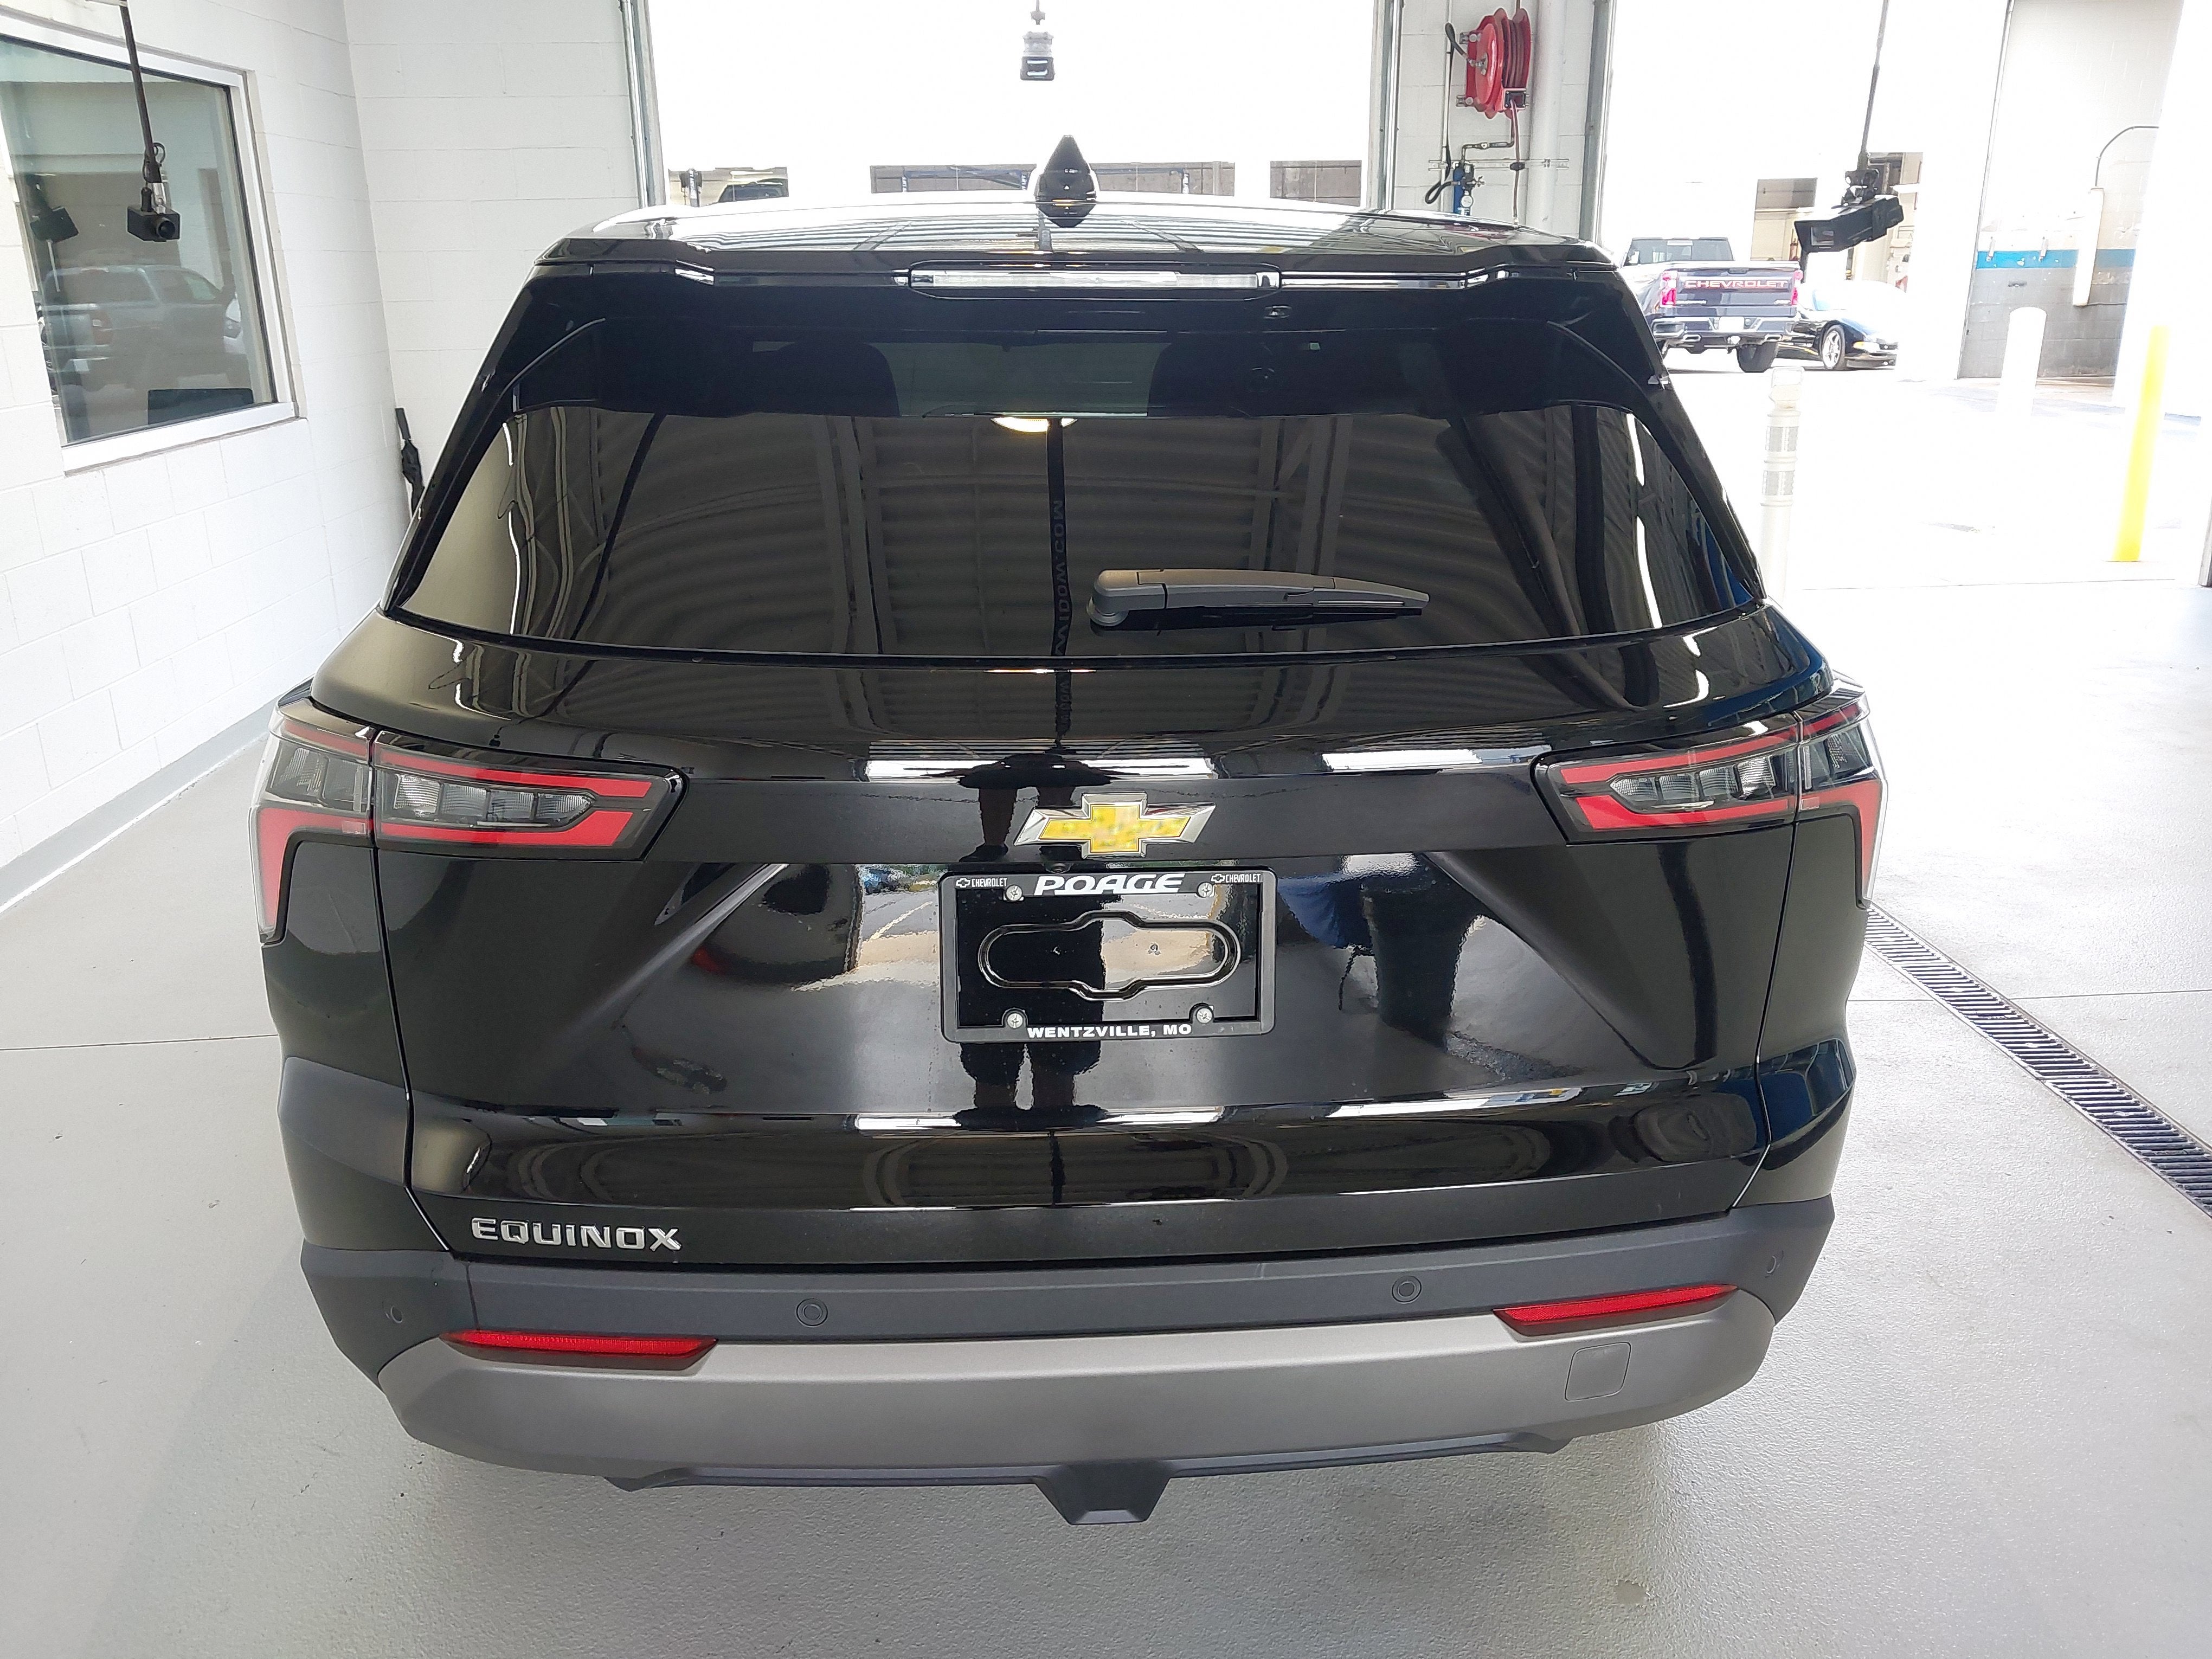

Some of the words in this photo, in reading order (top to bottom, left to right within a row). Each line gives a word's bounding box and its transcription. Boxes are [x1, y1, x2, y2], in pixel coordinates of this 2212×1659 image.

[972, 878, 1007, 888] CHEVROLET
[1034, 872, 1185, 896] POAGE
[1225, 873, 1261, 883] CHEVROLET
[1027, 1025, 1156, 1038] WENTZVILLE,
[1163, 1024, 1192, 1035] MO
[471, 1217, 681, 1251] EQUINOX
